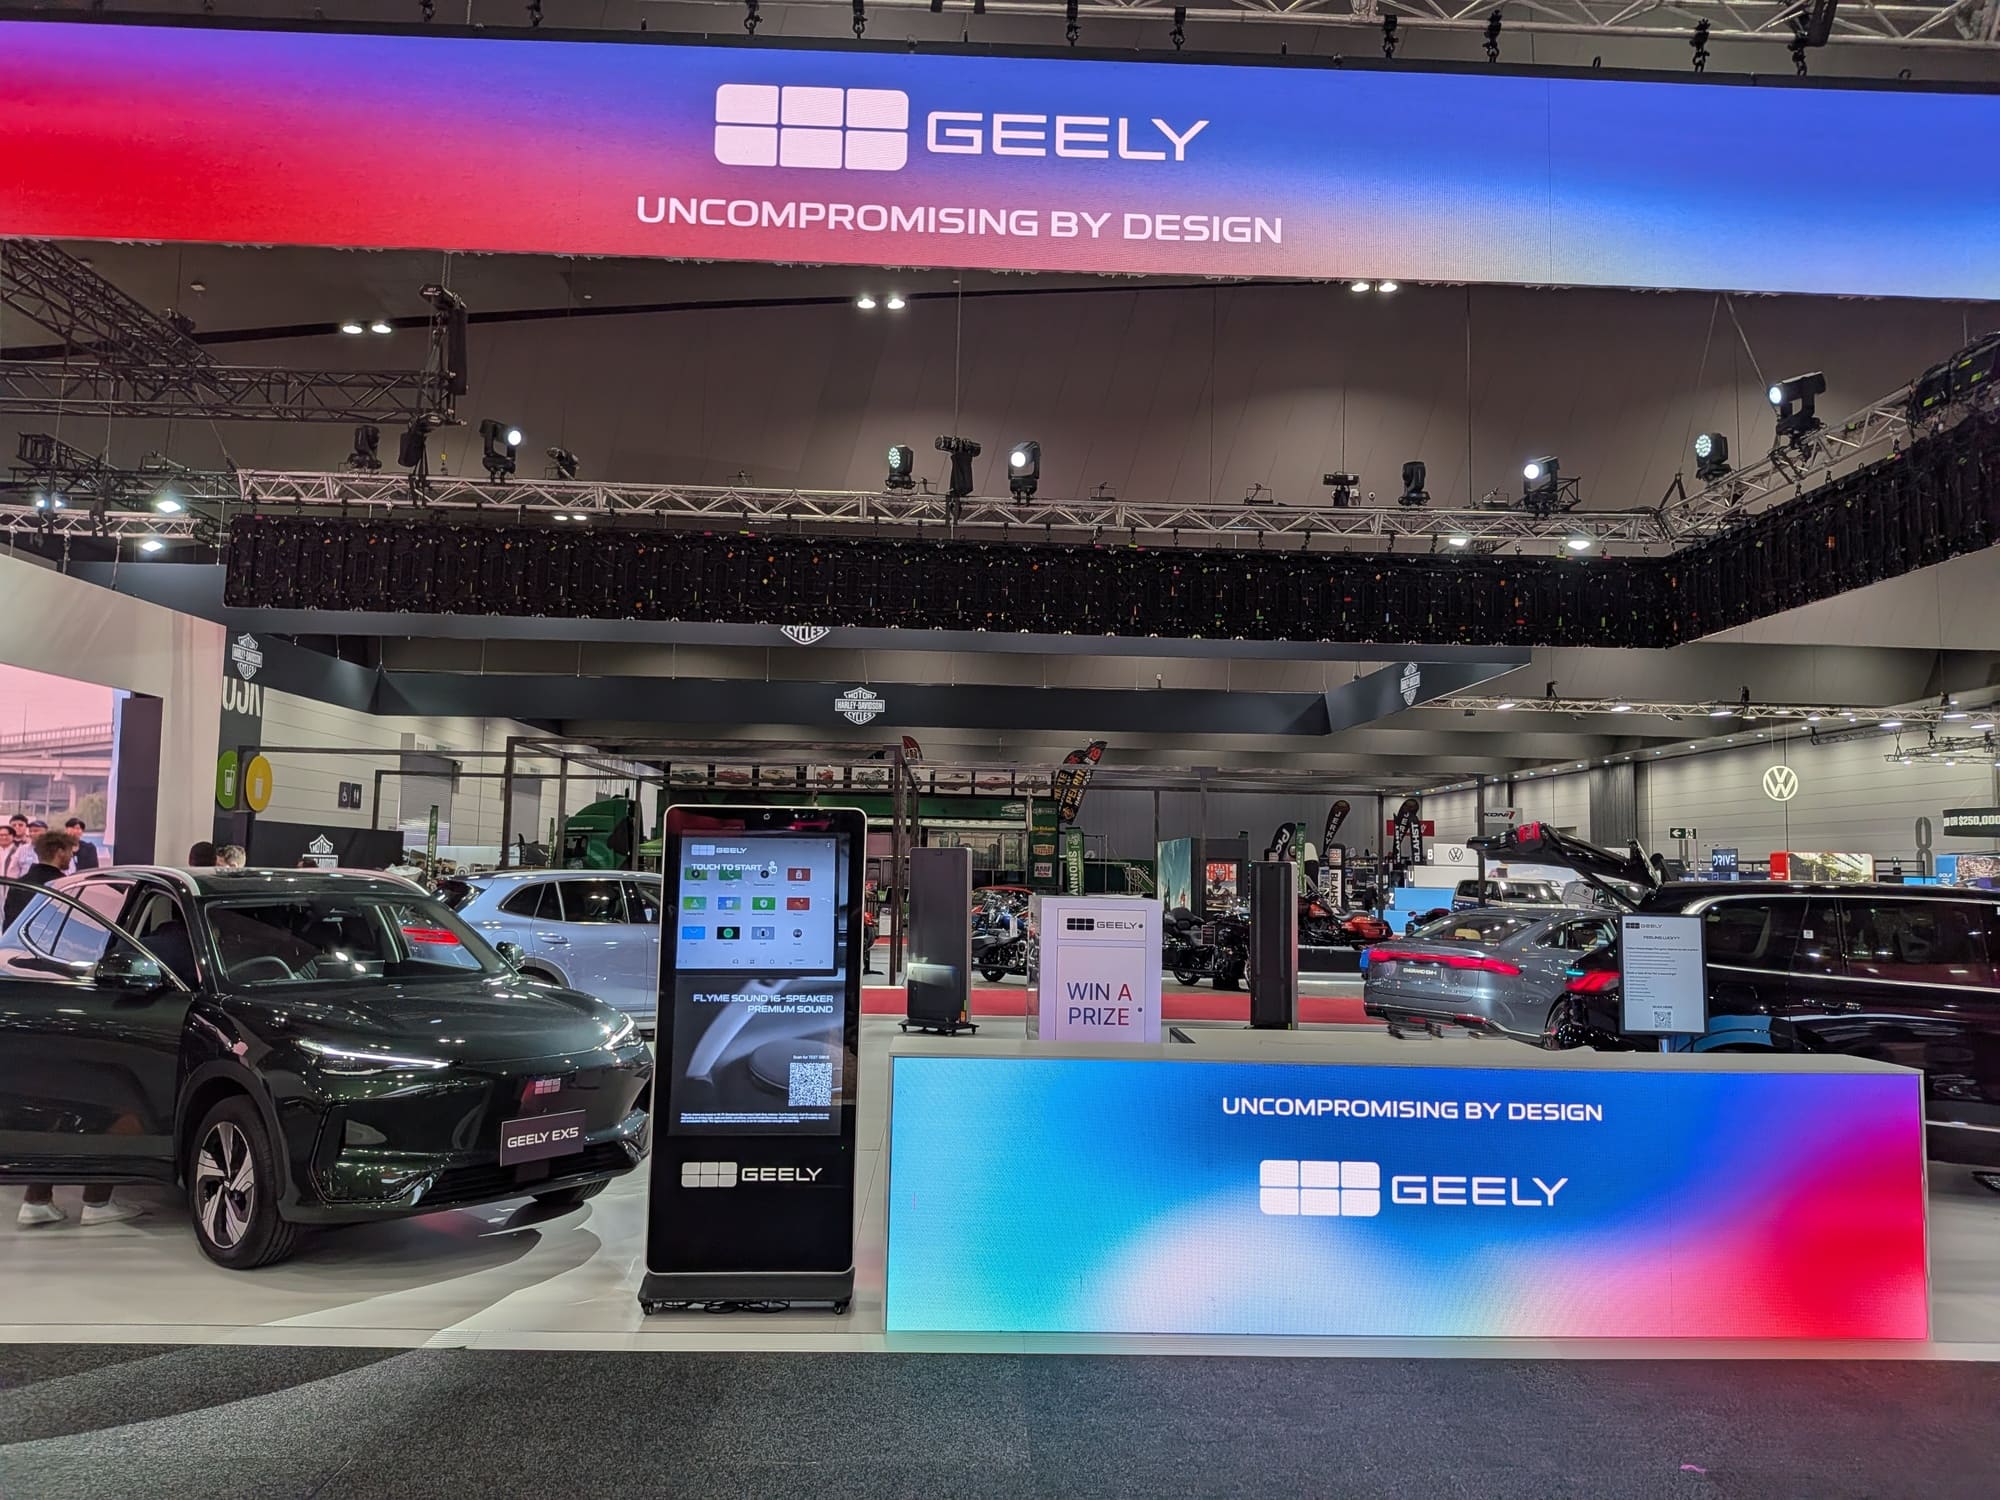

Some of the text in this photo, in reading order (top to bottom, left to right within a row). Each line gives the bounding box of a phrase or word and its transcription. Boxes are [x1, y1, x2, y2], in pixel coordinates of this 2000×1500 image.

[927, 111, 1209, 161] GEELY
[637, 196, 1282, 244] UNCOMPROMISING BY DESIGN
[787, 625, 824, 641] CYCLES
[847, 690, 873, 699] MOTOR
[837, 701, 883, 710] HARLEY-DAVIDSON
[847, 712, 872, 722] CYCLES
[1713, 855, 1736, 866] DRIVE
[1096, 921, 1137, 930] GEELY
[693, 994, 834, 1003] FLYME SOUND 16-SPEAKER
[1067, 982, 1133, 1001] WIN A
[747, 1005, 834, 1013] PREMIUM SOUND
[1068, 1007, 1130, 1026] PRIZE
[1223, 1097, 1602, 1121] UNCOMPROMISING BY DESIGN
[507, 1126, 579, 1148] GEELY EX5
[741, 1167, 823, 1182] GEELY
[1392, 1176, 1568, 1206] GEELY
